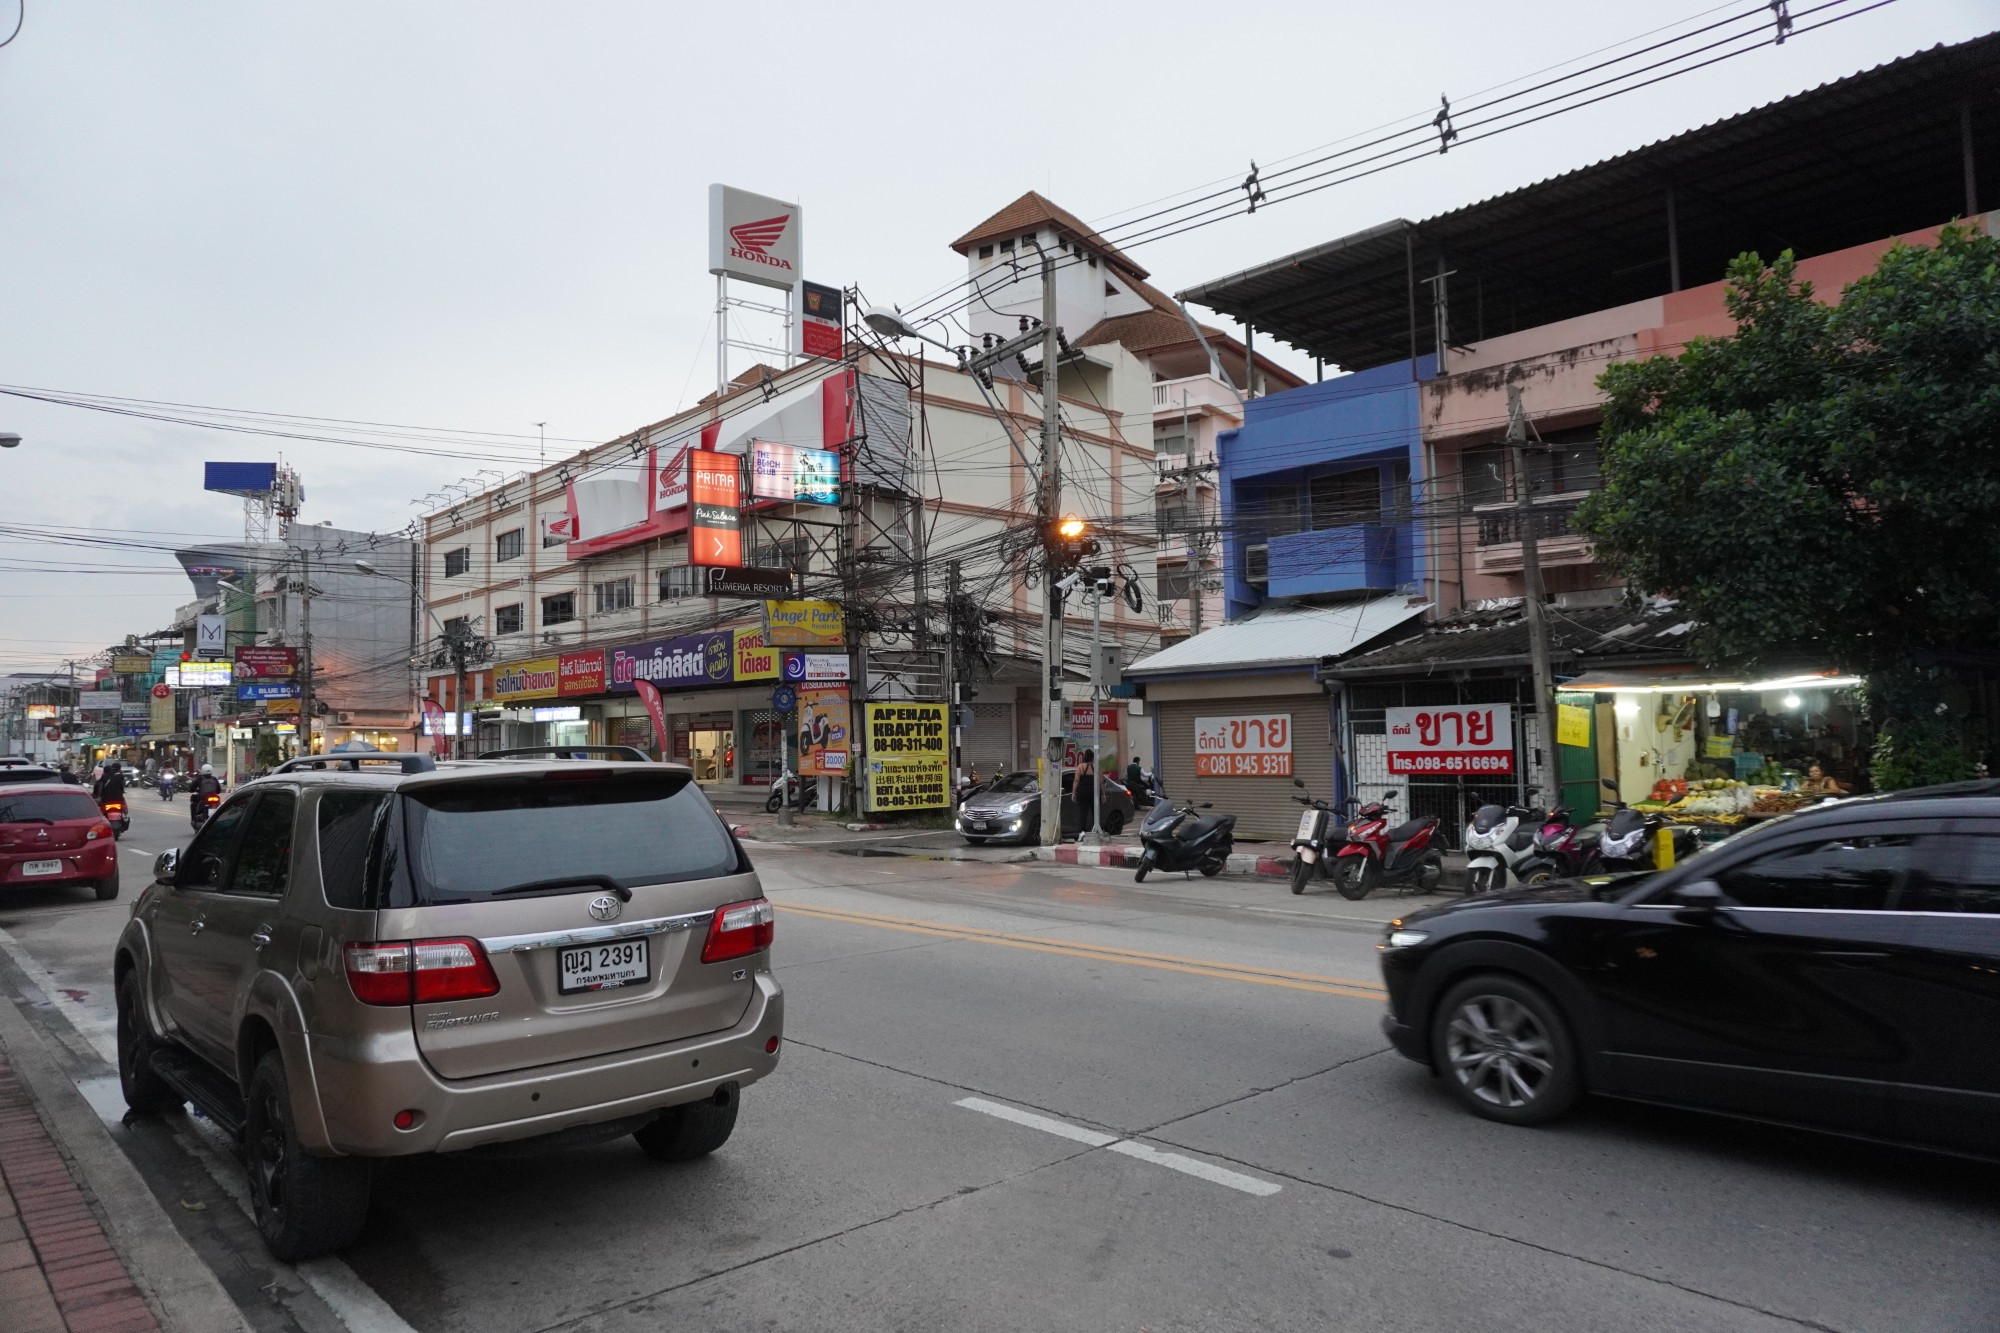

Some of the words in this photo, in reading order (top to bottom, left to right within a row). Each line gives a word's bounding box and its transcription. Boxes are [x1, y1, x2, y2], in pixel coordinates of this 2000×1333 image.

[729, 247, 793, 270] HONDA
[757, 450, 770, 458] THE
[757, 458, 780, 468] BEACH
[757, 467, 776, 475] CLUB
[696, 470, 735, 488] PRIMA
[696, 508, 712, 519] Pink
[711, 510, 737, 522] Salmon
[753, 583, 782, 593] RESORT
[772, 607, 807, 624] Angel
[811, 608, 838, 622] Park
[738, 651, 771, 674] ได้เลย
[496, 668, 556, 693] รถใหม่ป้ายแดง
[873, 708, 942, 722] АРЕНДА
[873, 723, 943, 737] КВАРТИР
[1199, 727, 1227, 749] ตึกนี้
[1230, 718, 1287, 749] ขาย
[1415, 709, 1494, 747] ขาย
[873, 737, 943, 752] 08-08-311-400
[1210, 755, 1231, 774] 081
[1235, 755, 1258, 774] 945
[1263, 754, 1289, 774] 9311
[1392, 753, 1509, 770] โทร.098-6516694
[876, 773, 943, 785] 出租和出售房间
[876, 786, 893, 796] RENT
[894, 786, 900, 795] &
[902, 785, 917, 794] SALE
[919, 783, 943, 793] ROOMS
[876, 794, 944, 807] 08-08-311-400
[600, 943, 643, 968] 2391
[576, 969, 636, 985] กรุงเทพมหานคร
[424, 1011, 500, 1031] FORTUNER
